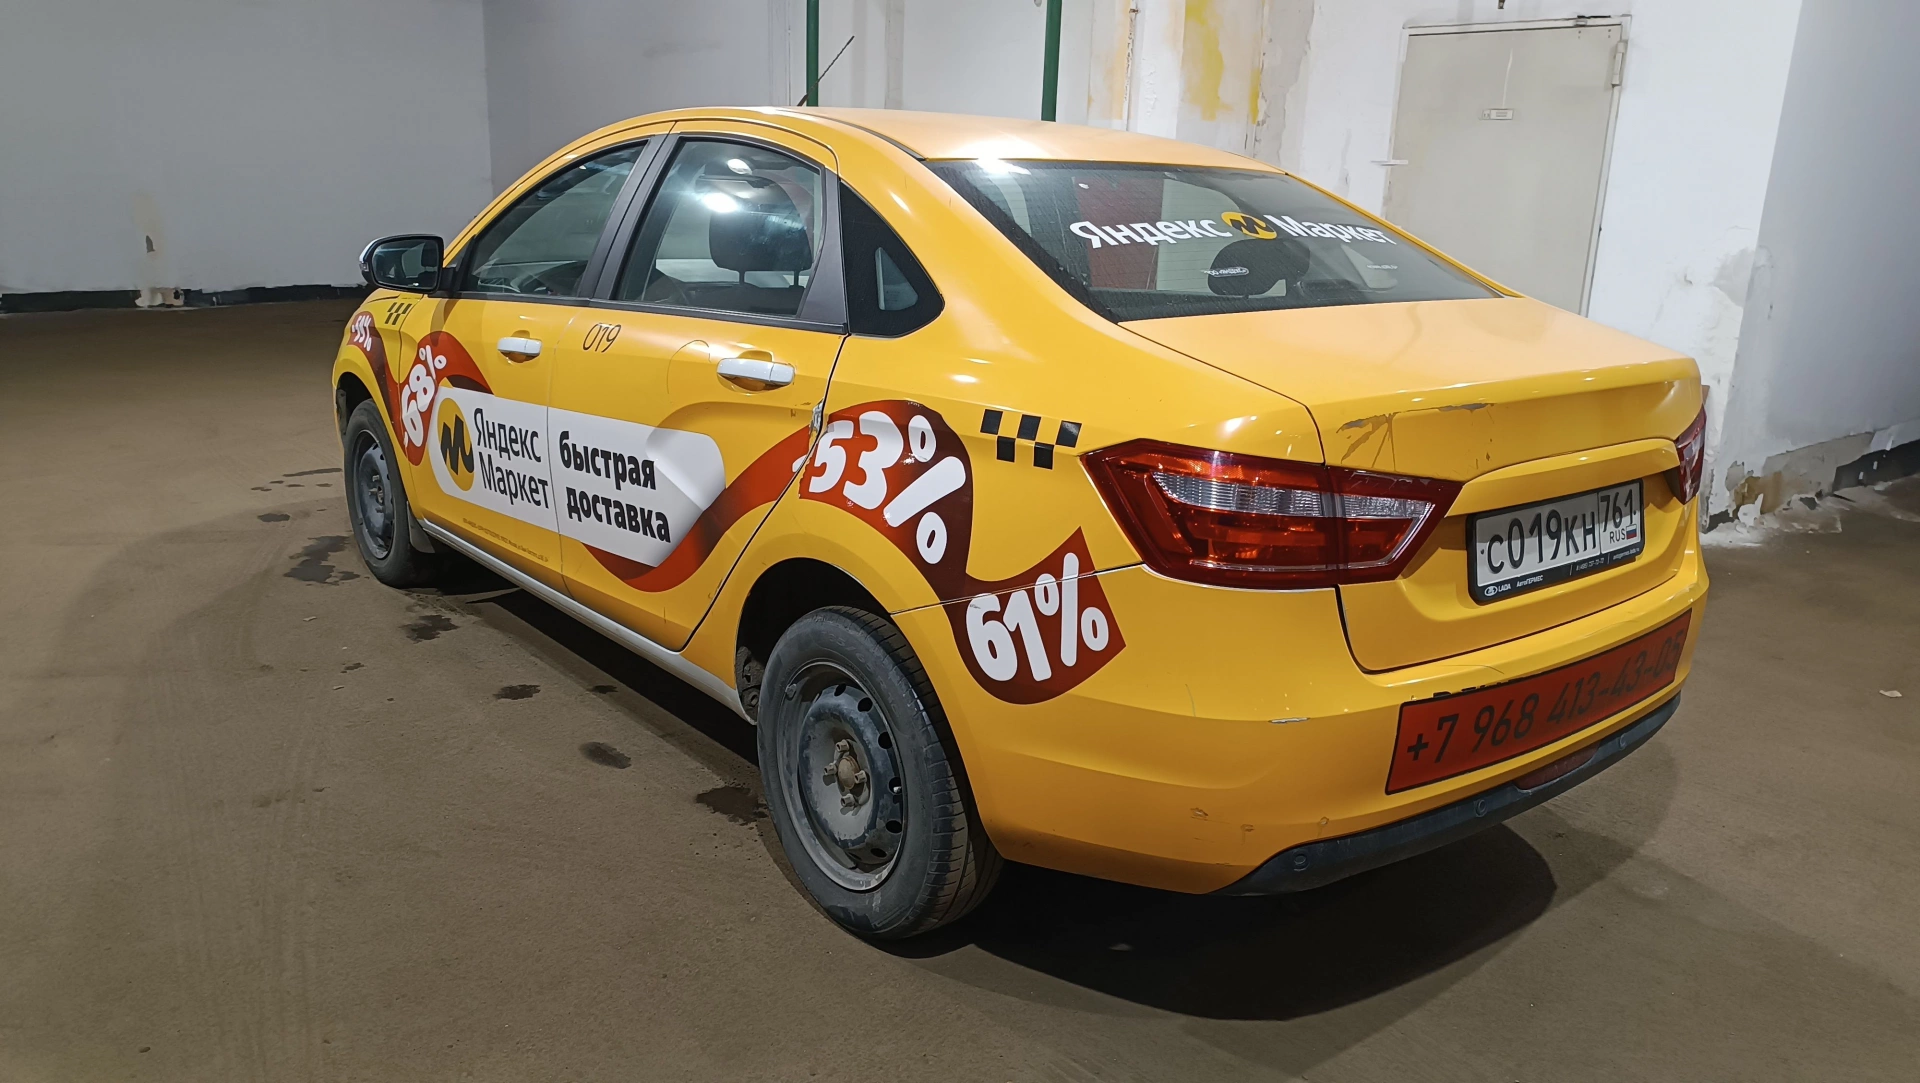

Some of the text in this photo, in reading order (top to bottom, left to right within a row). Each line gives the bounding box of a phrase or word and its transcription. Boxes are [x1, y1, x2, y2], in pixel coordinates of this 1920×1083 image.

[1069, 217, 1233, 249] Яндекс
[1264, 214, 1397, 246] Маркет
[582, 322, 622, 353] 019
[401, 344, 448, 448] -68%
[474, 407, 542, 463] Яндекс
[558, 430, 657, 491] быстрая
[478, 451, 549, 509] Маркет
[565, 486, 672, 543] доставка
[1600, 488, 1634, 533] 761
[1609, 528, 1626, 544] RUS
[1498, 583, 1512, 593] LADA
[965, 552, 1110, 682] 61%
[1406, 627, 1685, 764] +7 968 413-43-05
